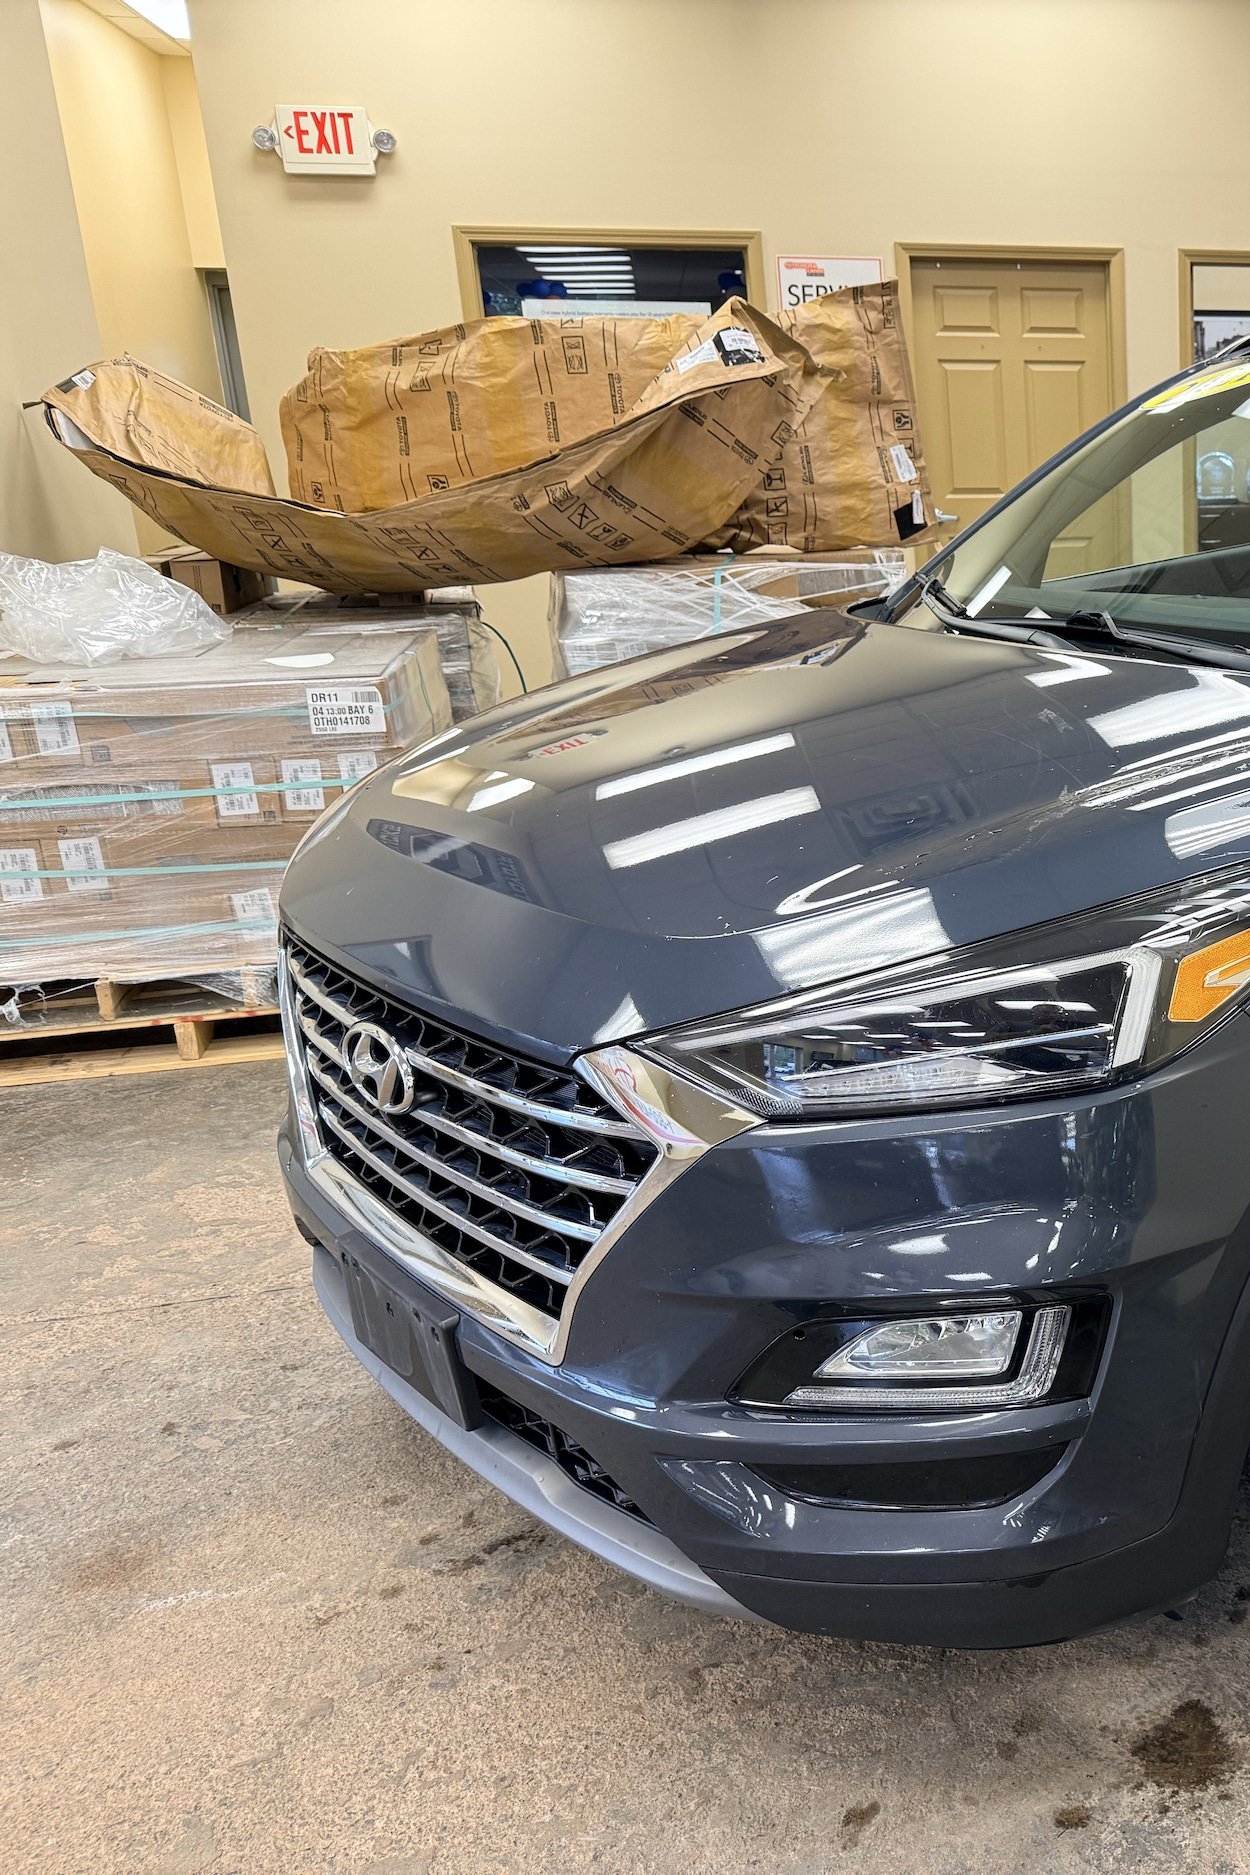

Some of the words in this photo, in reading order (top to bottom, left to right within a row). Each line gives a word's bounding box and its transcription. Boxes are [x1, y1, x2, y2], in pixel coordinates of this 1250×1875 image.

[293, 111, 354, 154] EXIT
[617, 385, 625, 414] TOYOTA
[396, 416, 404, 444] TOYOTA
[544, 402, 552, 430] TOYOTA
[311, 693, 338, 703] DR11
[312, 707, 324, 716] 04
[348, 705, 364, 714] BAY
[368, 705, 374, 714] 6
